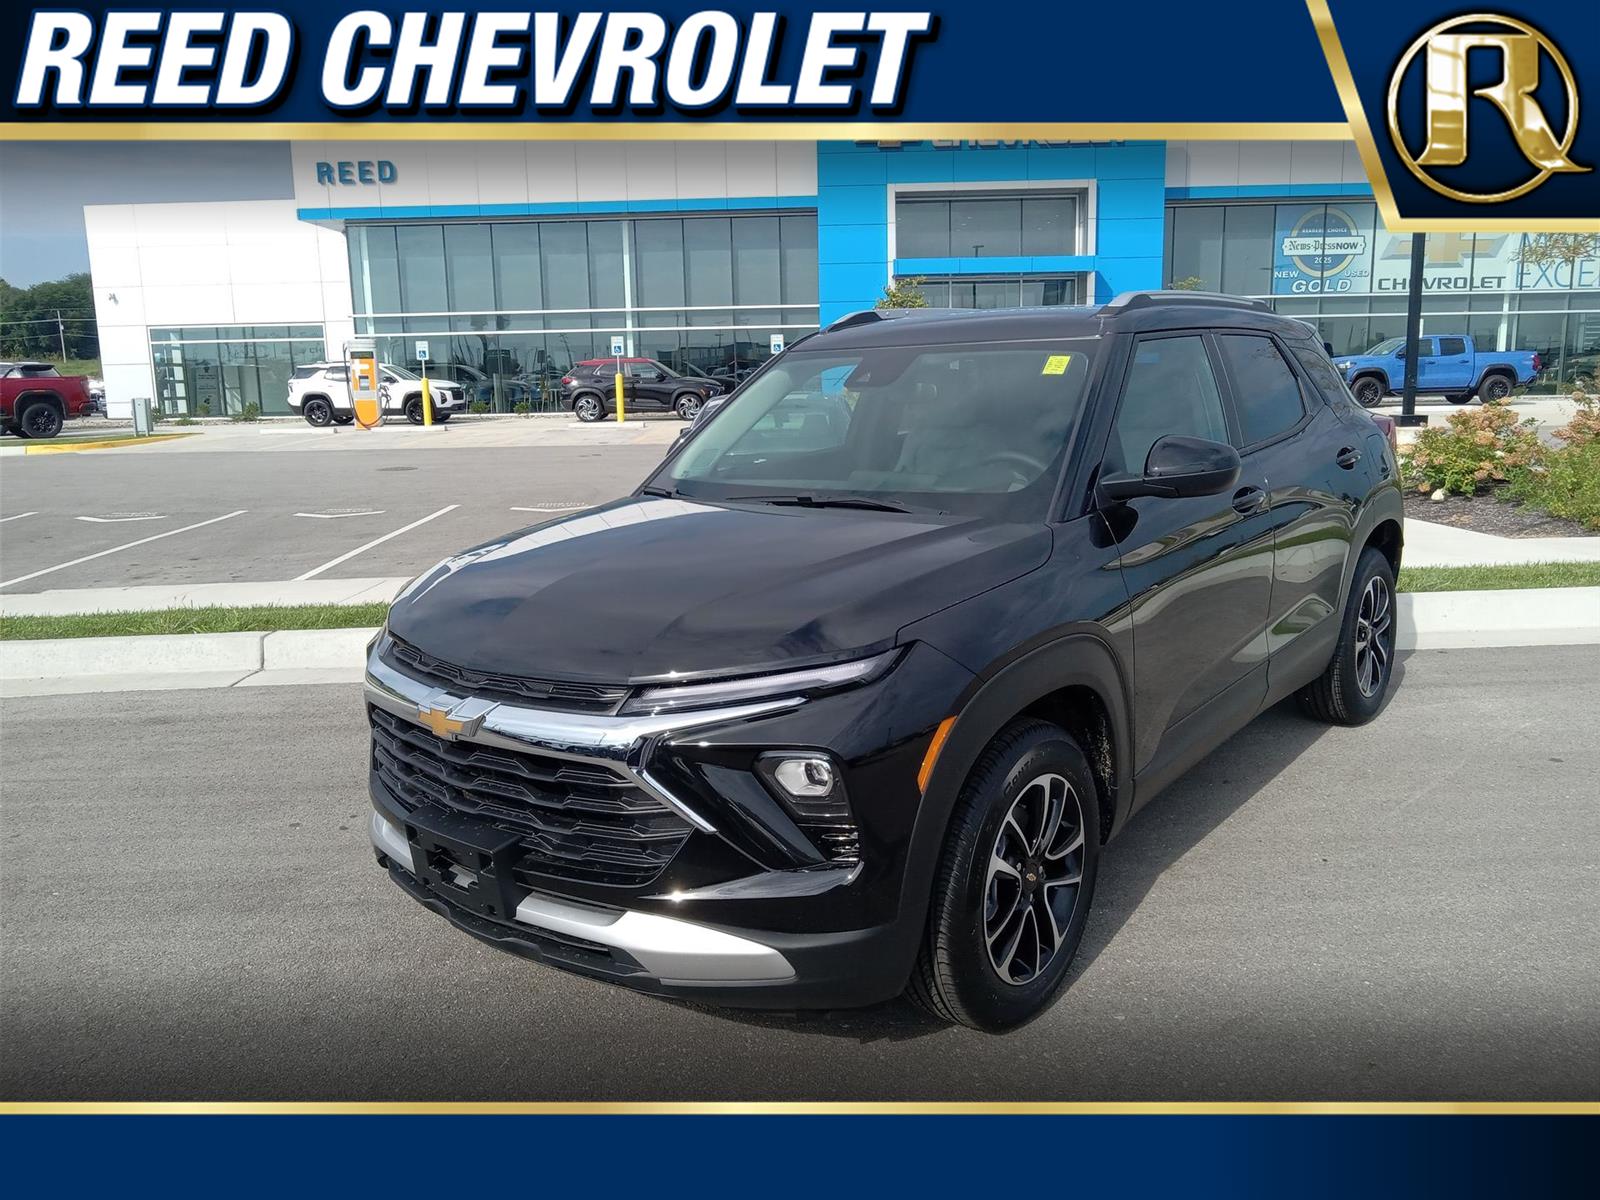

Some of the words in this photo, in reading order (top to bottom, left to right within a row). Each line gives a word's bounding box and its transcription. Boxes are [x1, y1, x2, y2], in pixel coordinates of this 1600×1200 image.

[316, 160, 398, 185] REED
[1274, 270, 1299, 278] NEW
[1344, 270, 1370, 278] USED
[1515, 259, 1600, 288] EXCE
[1291, 279, 1352, 293] GOLD
[1378, 276, 1507, 291] CHVROLET
